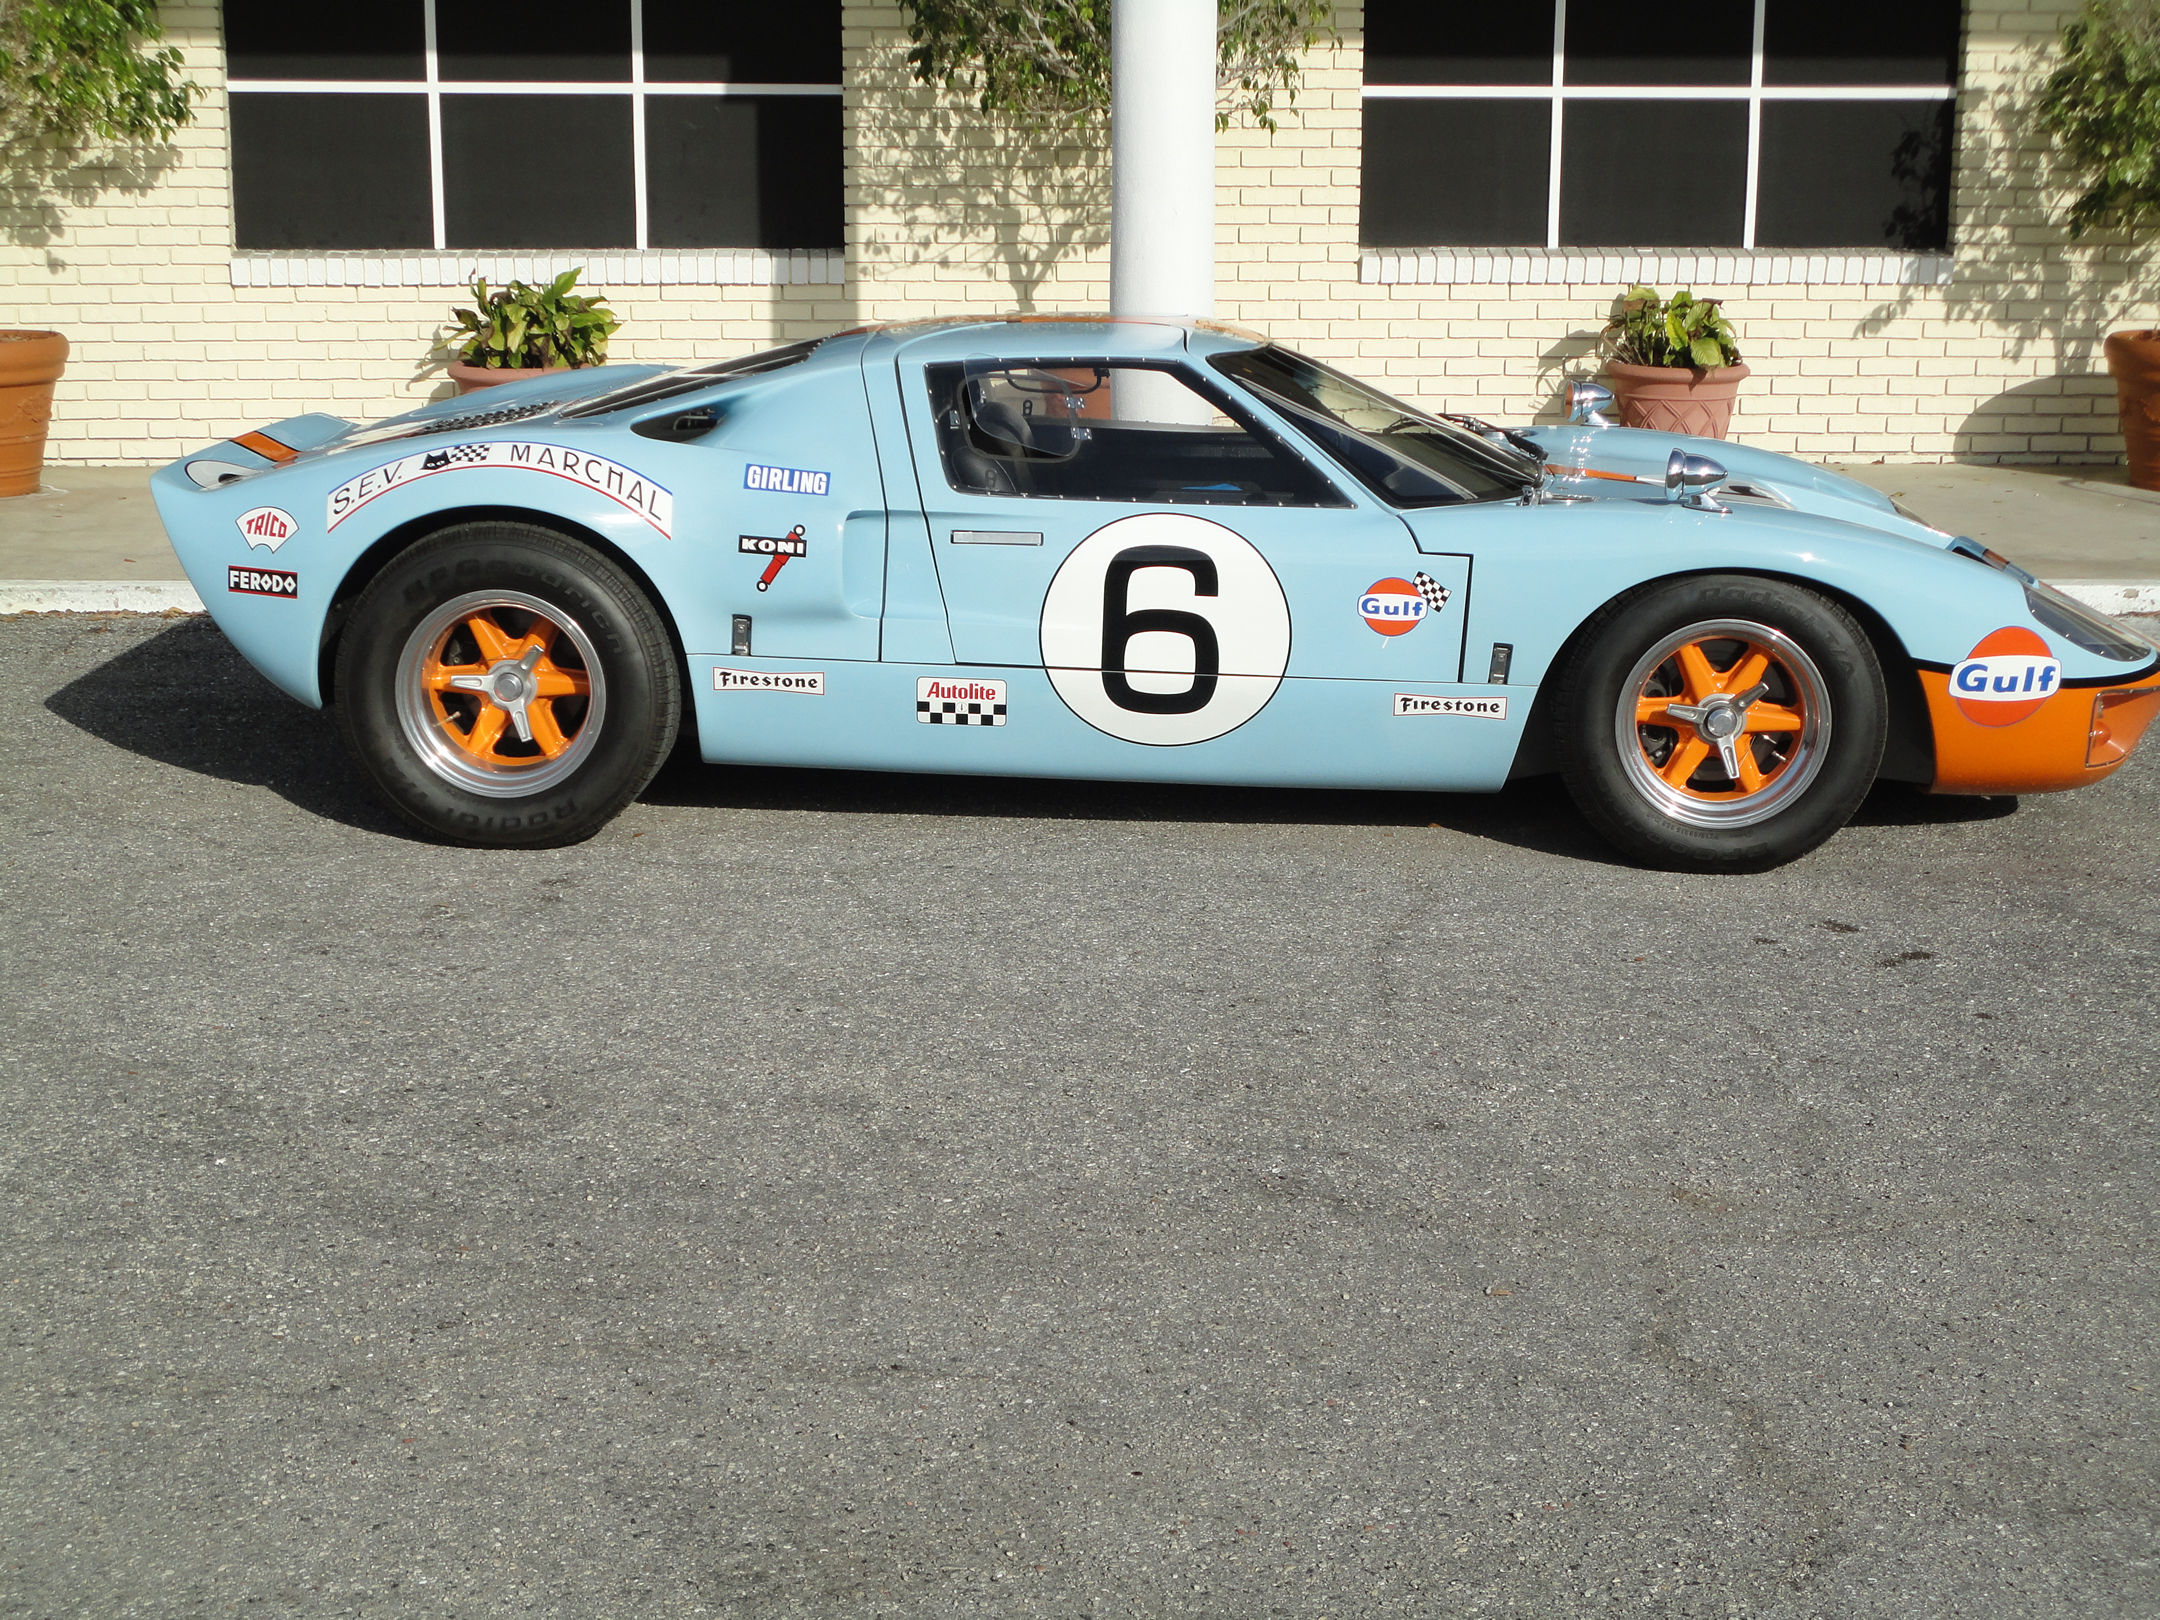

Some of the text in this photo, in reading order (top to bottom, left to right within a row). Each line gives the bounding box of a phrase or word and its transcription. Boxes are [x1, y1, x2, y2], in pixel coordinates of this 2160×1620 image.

[332, 445, 662, 521] S.E.V. MARCHAL
[747, 465, 828, 495] GIRLING
[246, 512, 287, 538] TRICO
[741, 538, 804, 554] KONI
[229, 570, 297, 593] FERODO
[1361, 597, 1424, 616] Gulf
[1101, 545, 1219, 714] 6
[719, 671, 818, 689] Firestone
[1956, 664, 2056, 693] Gulf
[927, 681, 996, 701] Autolite
[1400, 697, 1501, 713] Firestone
